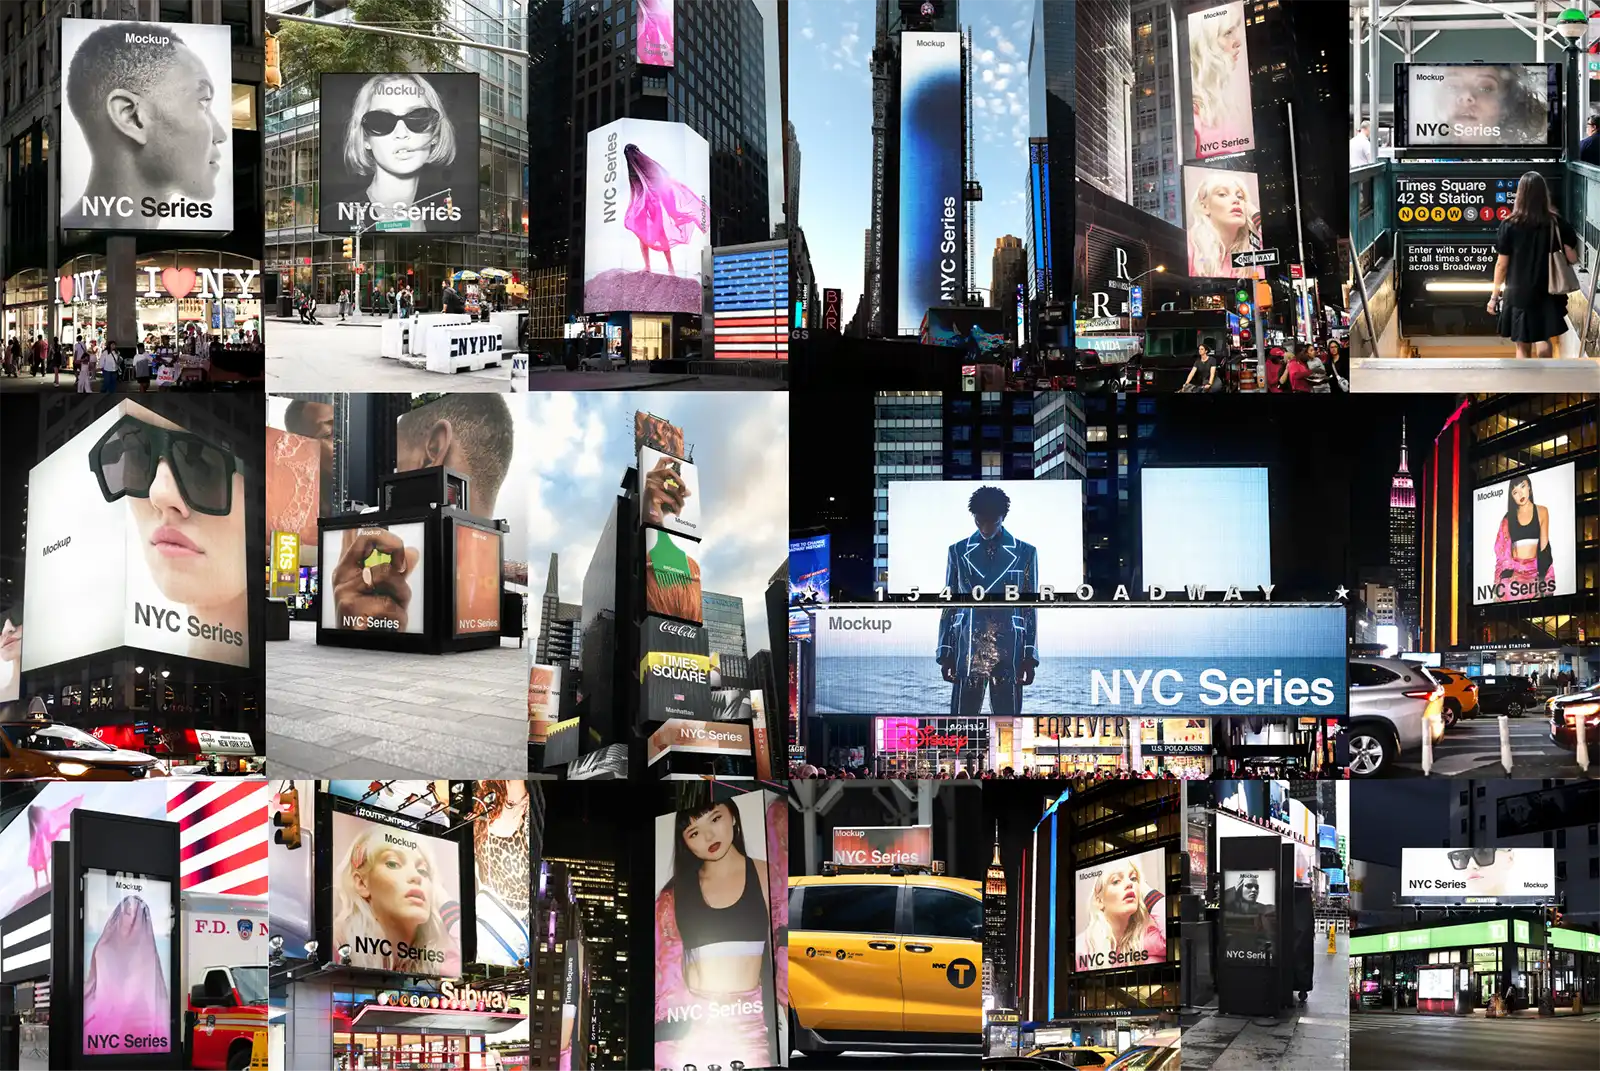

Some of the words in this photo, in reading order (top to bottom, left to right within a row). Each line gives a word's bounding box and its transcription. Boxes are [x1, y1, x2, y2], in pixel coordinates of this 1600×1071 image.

[1204, 10, 1227, 20] Mockup
[125, 32, 169, 47] Mockup
[917, 40, 945, 48] Mockup
[1416, 74, 1444, 82] Mockup
[374, 84, 426, 99] Mockup
[1416, 124, 1449, 137] NYC
[1454, 123, 1501, 137] Series
[1200, 142, 1219, 153] NYC
[1222, 138, 1249, 148] Series
[604, 132, 618, 184] Series
[1397, 180, 1436, 191] Times
[1441, 180, 1486, 192] Square
[603, 187, 617, 224] NYC
[1397, 193, 1414, 204] 42
[1420, 193, 1434, 204] St
[1439, 193, 1484, 204] Station
[82, 196, 134, 217] NYC
[140, 197, 213, 218] Series
[338, 202, 386, 220] NYC
[393, 201, 462, 221] Series
[941, 196, 955, 253] Series
[1471, 246, 1487, 255] buy
[1116, 248, 1132, 280] R
[1443, 263, 1487, 272] Broadway
[74, 270, 100, 301] NY
[144, 266, 161, 298] I
[198, 268, 260, 299] NY
[941, 259, 956, 300] NYC
[826, 291, 838, 329] BAR
[1092, 292, 1117, 319] R
[459, 335, 496, 356] NYPD
[1477, 488, 1503, 501] Mockup
[675, 517, 696, 529] Mockup
[43, 535, 71, 557] Mockup
[280, 535, 297, 570] tkts
[1005, 584, 1275, 602] BROADWAY
[1477, 583, 1506, 600] NYC
[1510, 579, 1556, 597] Series
[135, 602, 181, 633] NYC
[187, 616, 244, 648] Series
[343, 616, 364, 628] NYC
[366, 615, 399, 630] Series
[459, 618, 476, 629] NYC
[477, 618, 498, 628] Series
[829, 617, 892, 634] Mockup
[662, 654, 698, 670] TIMES
[653, 664, 706, 684] SQUARE
[1090, 669, 1184, 706] NYC
[1199, 668, 1334, 707] Series
[666, 707, 694, 716] Manhattan
[681, 728, 706, 740] NYC
[708, 730, 743, 742] Series
[1036, 716, 1124, 738] FOREVER
[385, 834, 417, 849] Mockup
[835, 829, 865, 838] Mockup
[835, 851, 866, 864] NYC
[872, 850, 918, 864] Series
[1079, 870, 1102, 880] Mockup
[116, 881, 143, 892] Mockup
[1409, 880, 1432, 888] NYC
[1435, 880, 1466, 889] Series
[195, 920, 230, 934] F.D.
[356, 936, 392, 956] NYC
[397, 942, 445, 963] Series
[1079, 953, 1104, 968] NYC
[1108, 948, 1148, 965] Series
[953, 964, 969, 984] T
[440, 981, 510, 1012] Subway
[668, 1004, 703, 1023] NYC
[708, 998, 763, 1016] Series
[88, 1035, 120, 1048] NYC
[124, 1034, 167, 1048] Series
